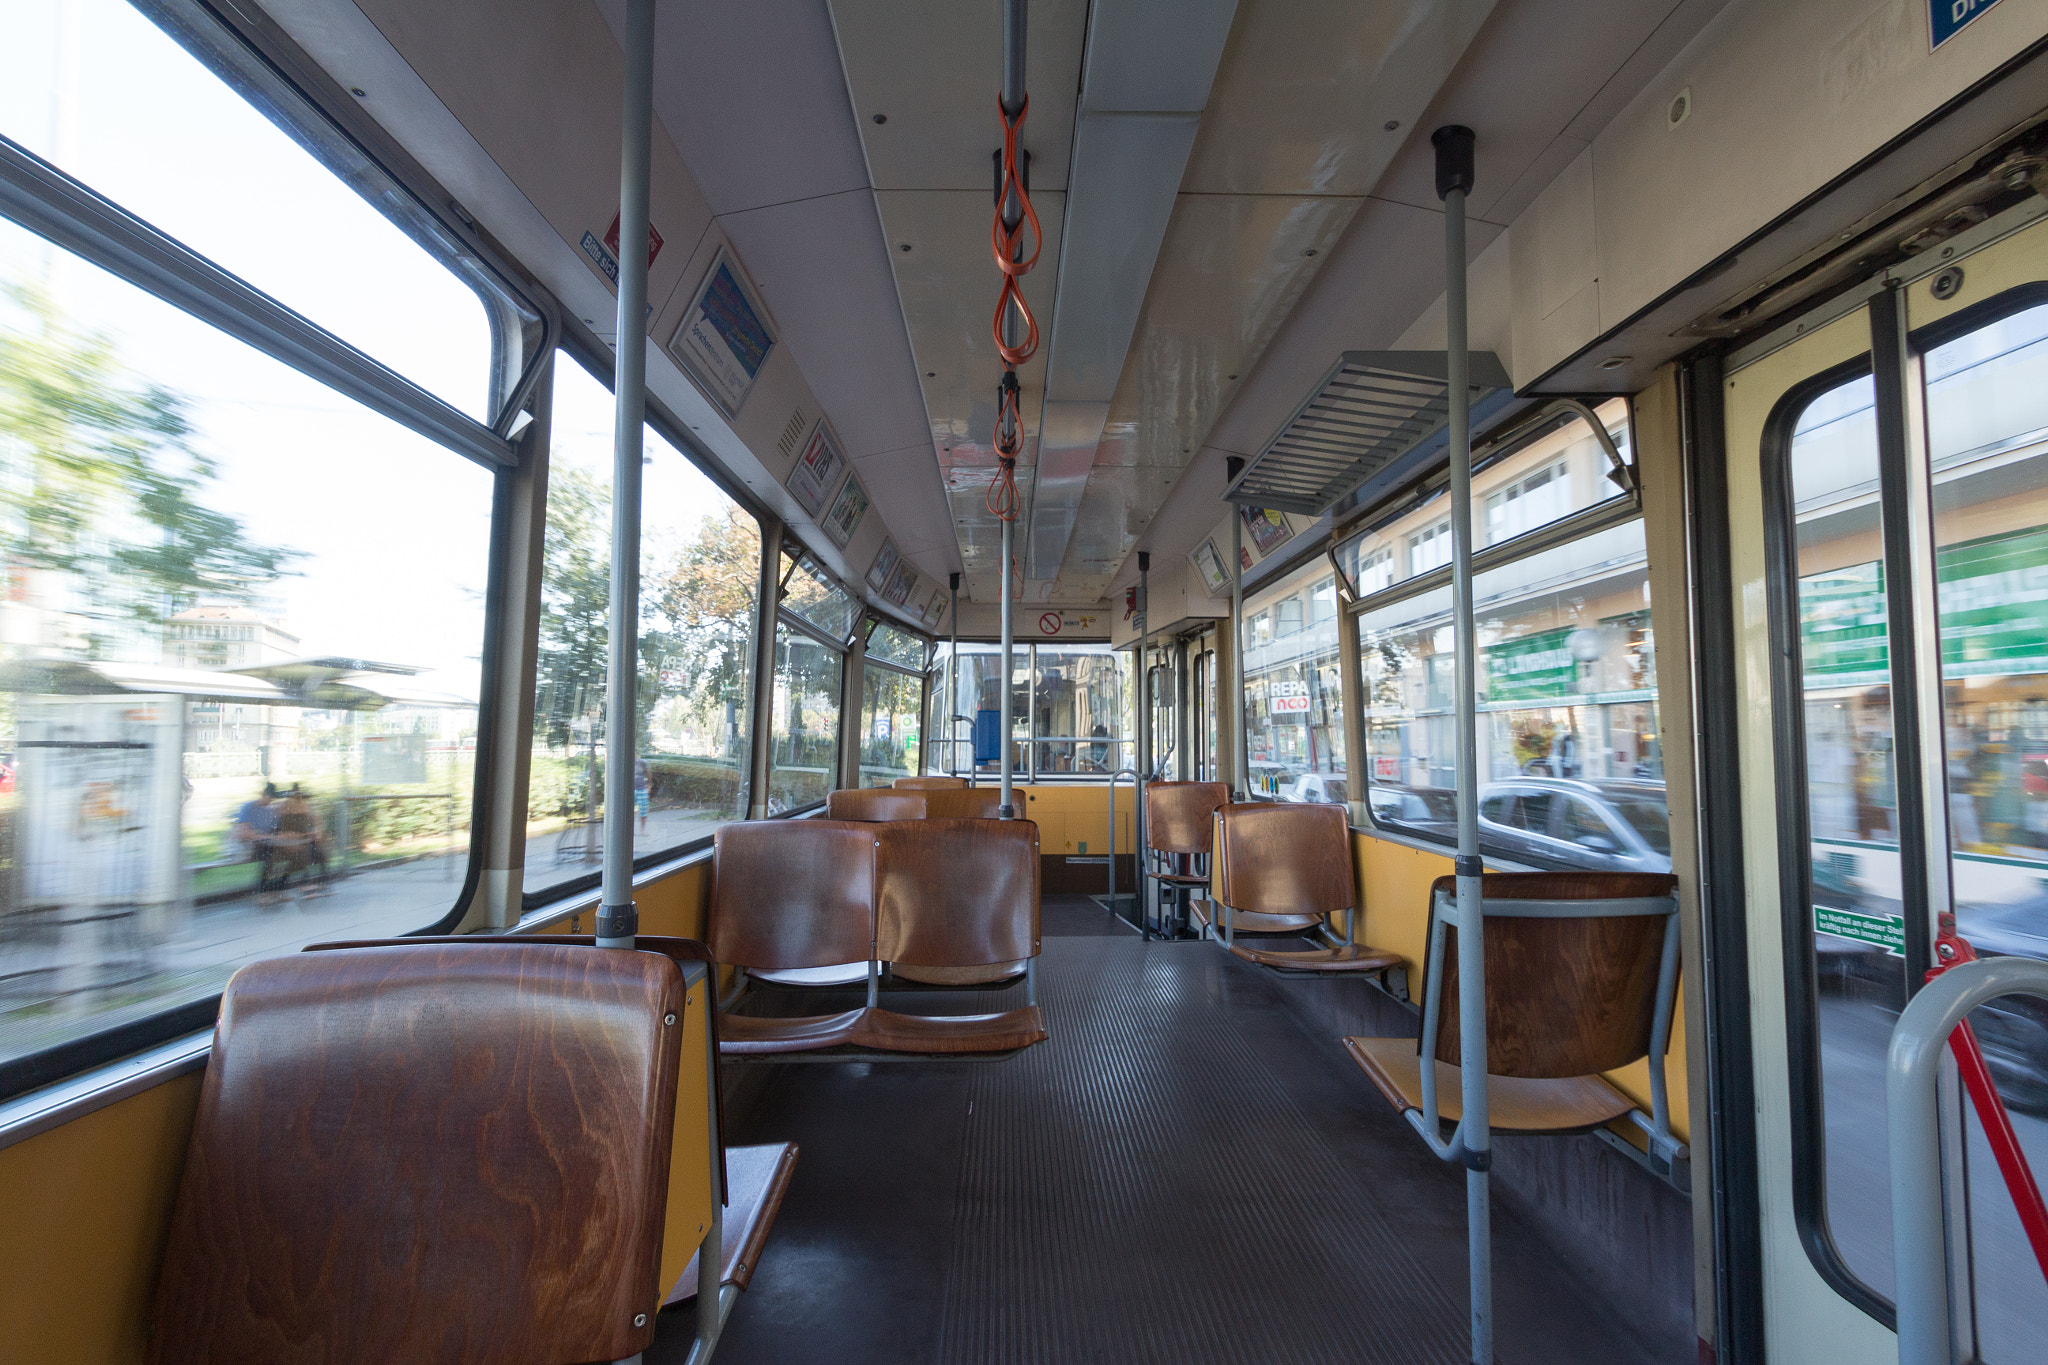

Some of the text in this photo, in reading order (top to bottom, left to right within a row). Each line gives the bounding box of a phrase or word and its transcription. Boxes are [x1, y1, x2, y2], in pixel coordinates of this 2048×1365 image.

[583, 234, 616, 278] Bitte sich
[1270, 681, 1309, 696] REPA
[1818, 912, 1828, 921] Im
[1828, 913, 1851, 925] Notfall
[1862, 920, 1886, 932] dieser
[1886, 925, 1904, 936] Stell
[1819, 921, 1904, 946] kräftig nach innen ziehe
